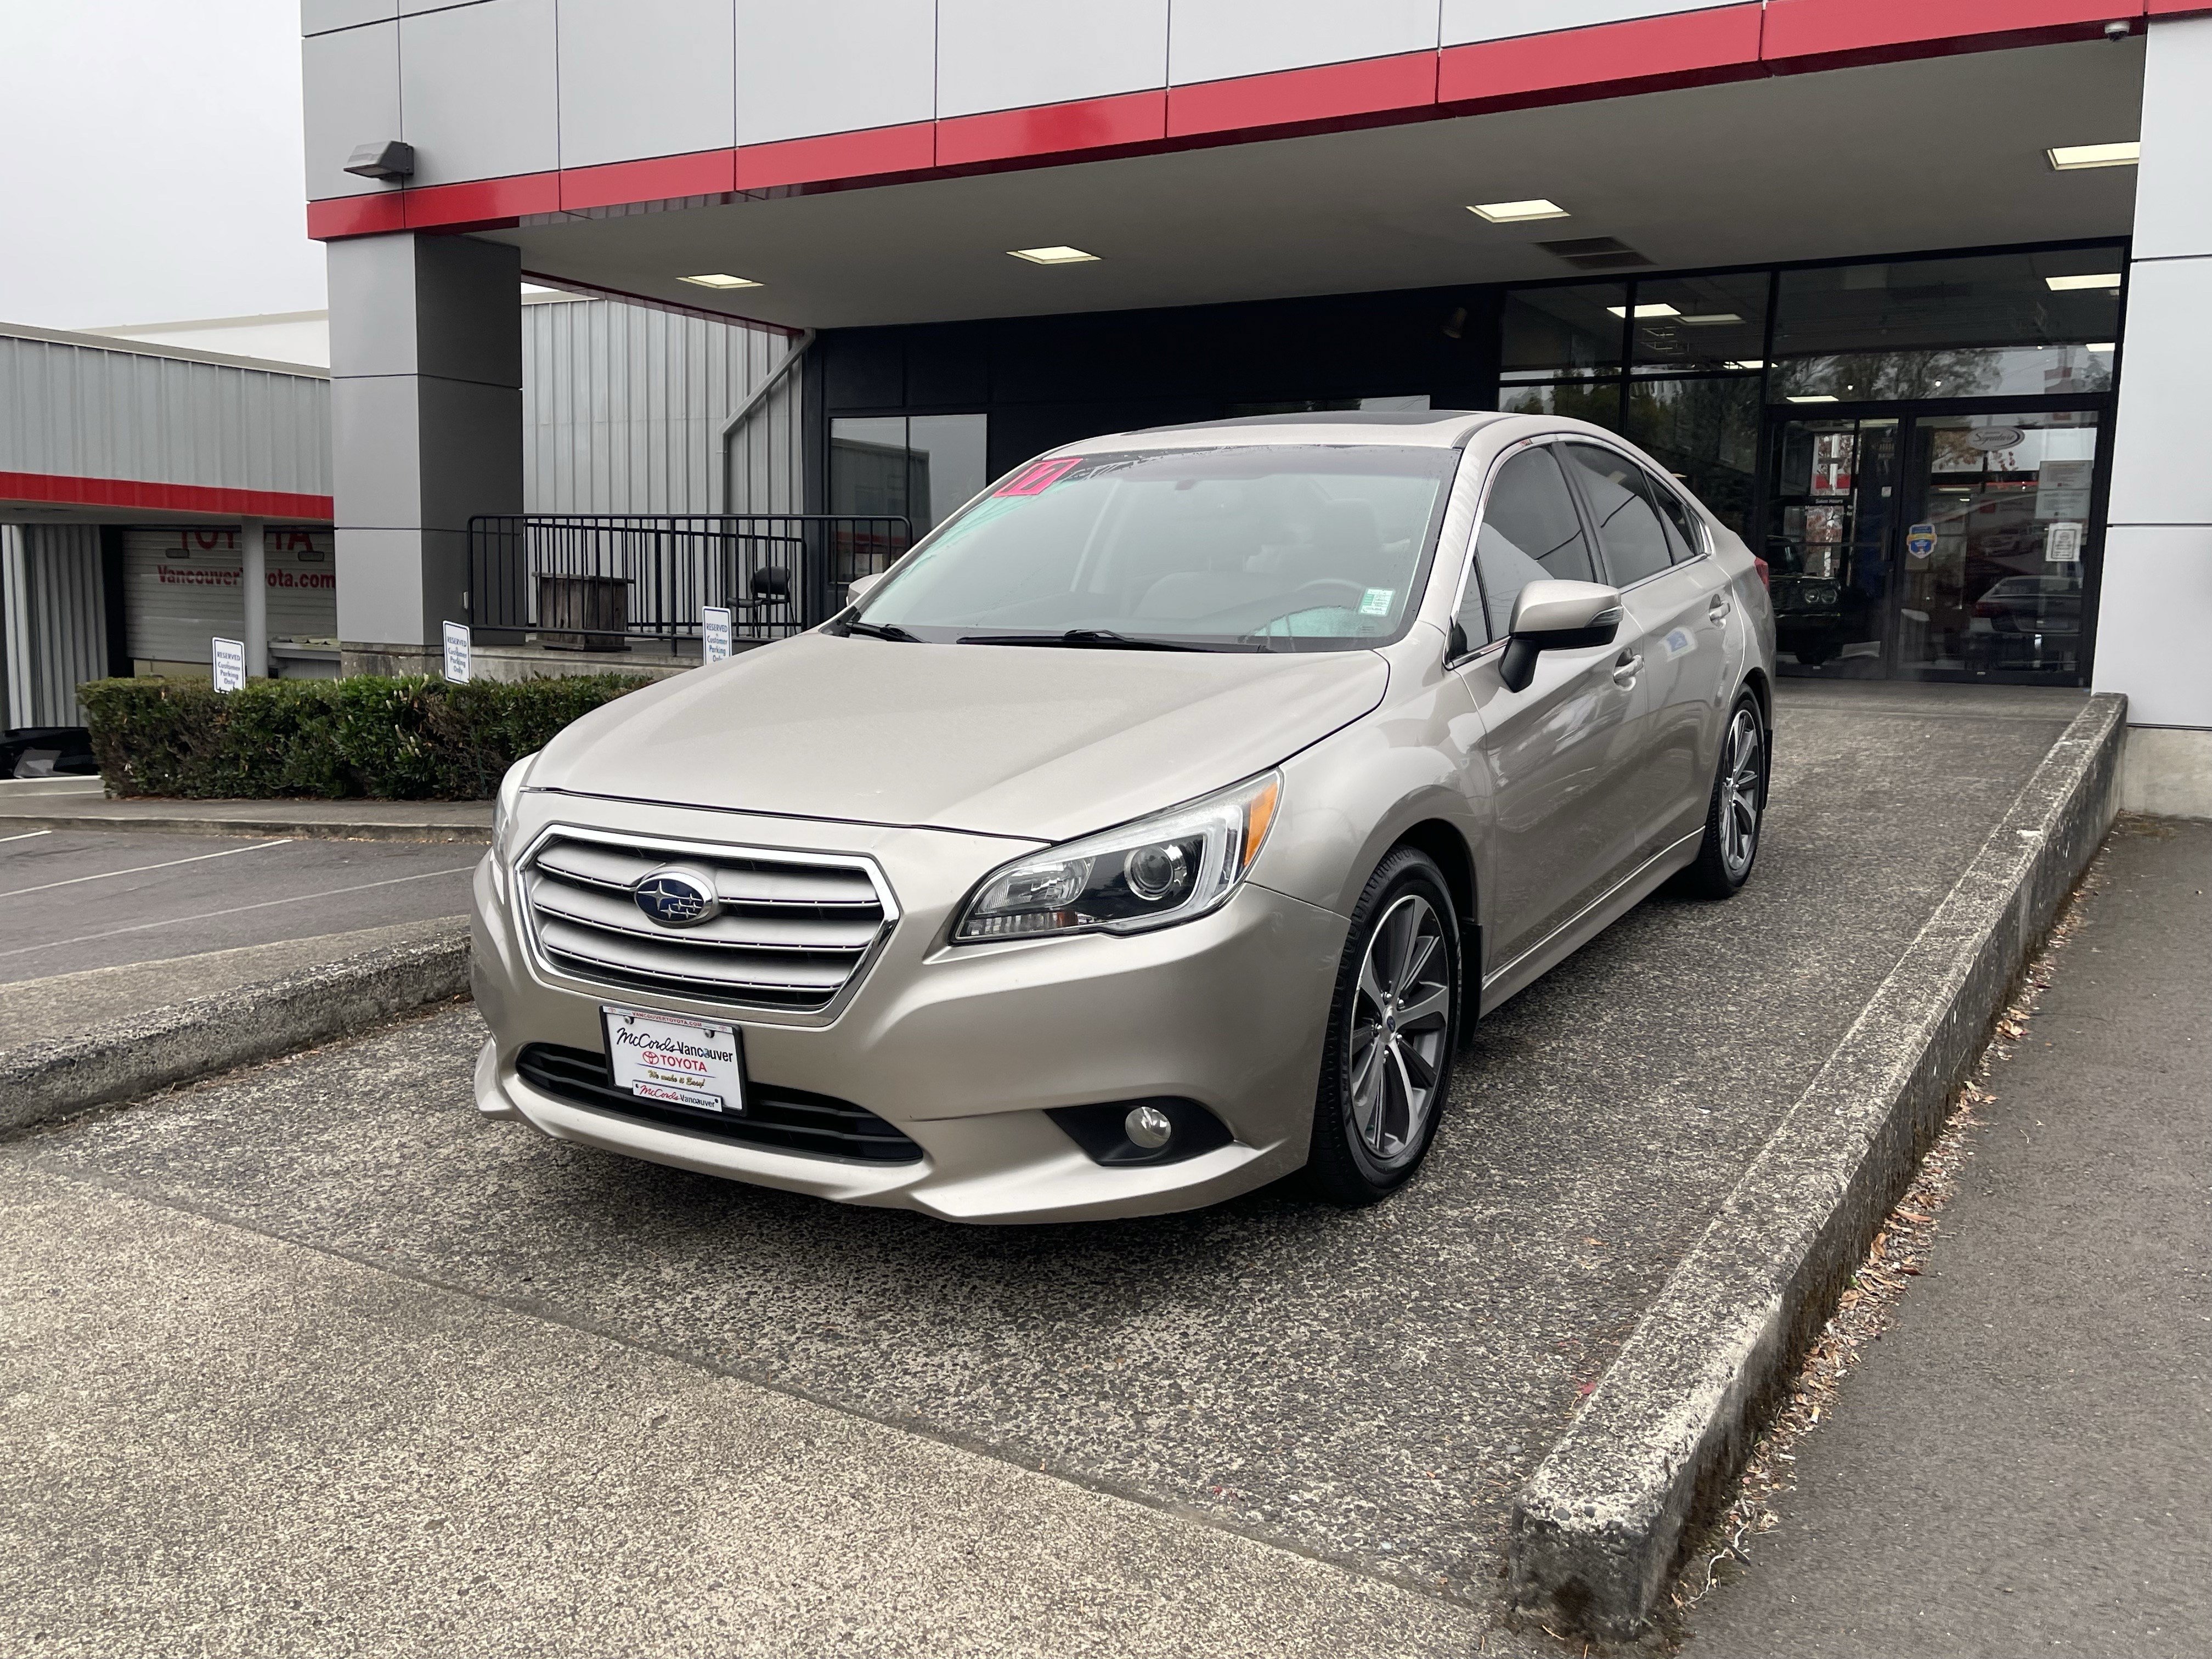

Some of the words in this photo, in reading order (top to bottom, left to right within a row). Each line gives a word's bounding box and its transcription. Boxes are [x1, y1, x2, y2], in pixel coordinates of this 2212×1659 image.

[157, 564, 336, 589] Vancouverota.com
[706, 623, 728, 633] RESERVED
[447, 636, 467, 647] RESERVED
[707, 635, 728, 645] Customer
[217, 651, 241, 661] RESERVED
[448, 647, 467, 658] Customer
[709, 645, 726, 657] Parking
[217, 661, 241, 672] Customer
[450, 656, 466, 668] Parking
[220, 669, 239, 680] Parking
[453, 665, 463, 675] Only
[224, 678, 235, 686] Only
[631, 1011, 702, 1028] VANCOUVERTOYOTA.COM
[659, 1054, 708, 1073] TOYOTA
[647, 1069, 659, 1080] We
[661, 1074, 678, 1083] make
